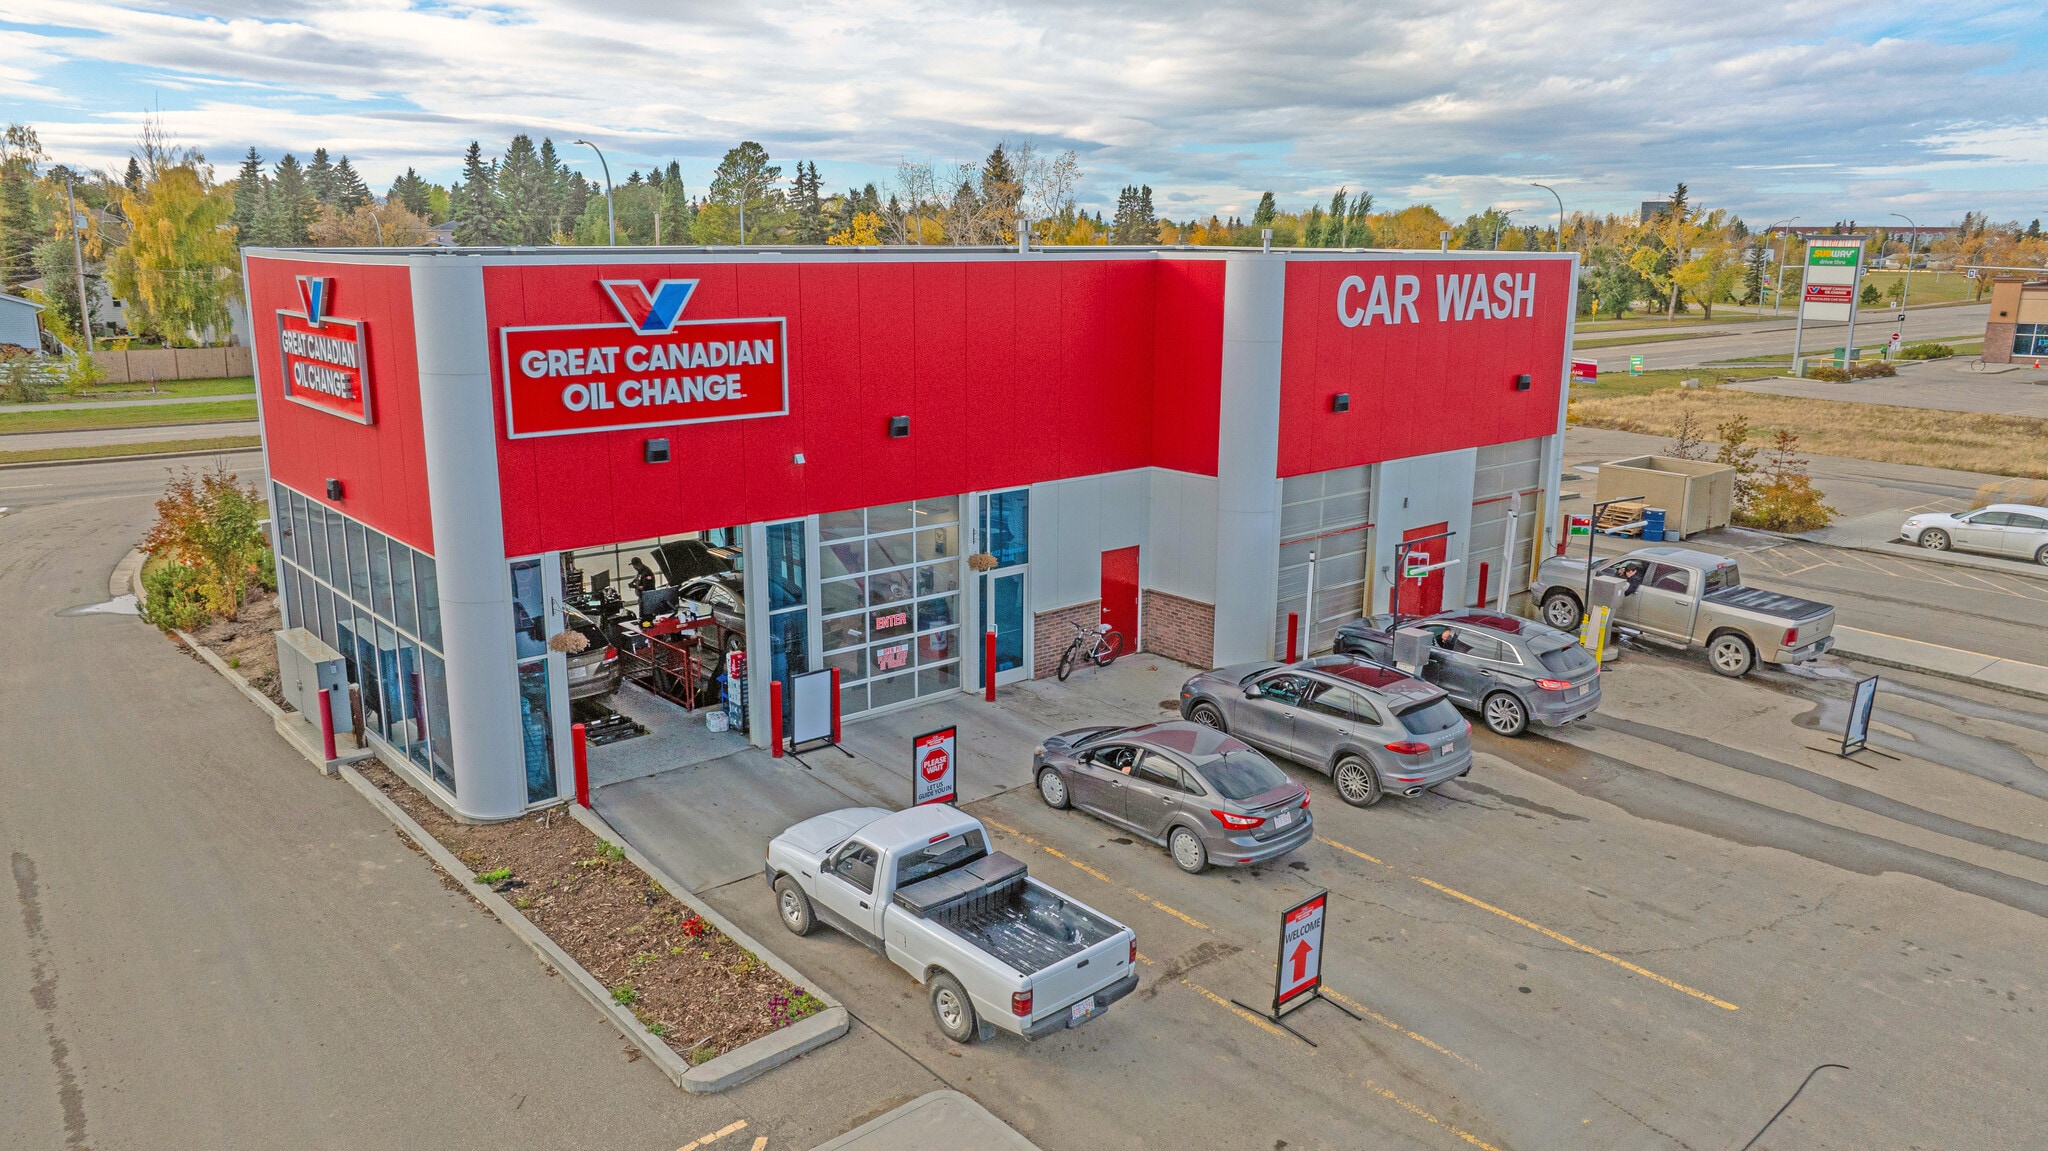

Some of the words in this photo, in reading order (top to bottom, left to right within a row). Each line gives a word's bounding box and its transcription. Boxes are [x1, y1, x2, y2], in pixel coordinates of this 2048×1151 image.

[1337, 275, 1420, 328] CAR
[1436, 272, 1536, 322] WASH
[282, 330, 307, 357] GREAT
[307, 335, 356, 369] CANADIAN
[520, 347, 620, 379] GREAT
[624, 339, 774, 372] CANADIAN
[294, 361, 309, 386] OIL
[308, 365, 348, 399] CHANGE
[562, 382, 615, 412] OIL
[617, 373, 743, 408] CHANGE
[876, 612, 907, 630] ENTER
[923, 755, 947, 769] PLEASE
[926, 763, 944, 774] WAIT
[918, 789, 935, 800] GUIDE
[935, 786, 946, 795] YOU
[946, 784, 952, 792] IN
[927, 783, 937, 792] LET
[1285, 917, 1321, 944] WELCOME
